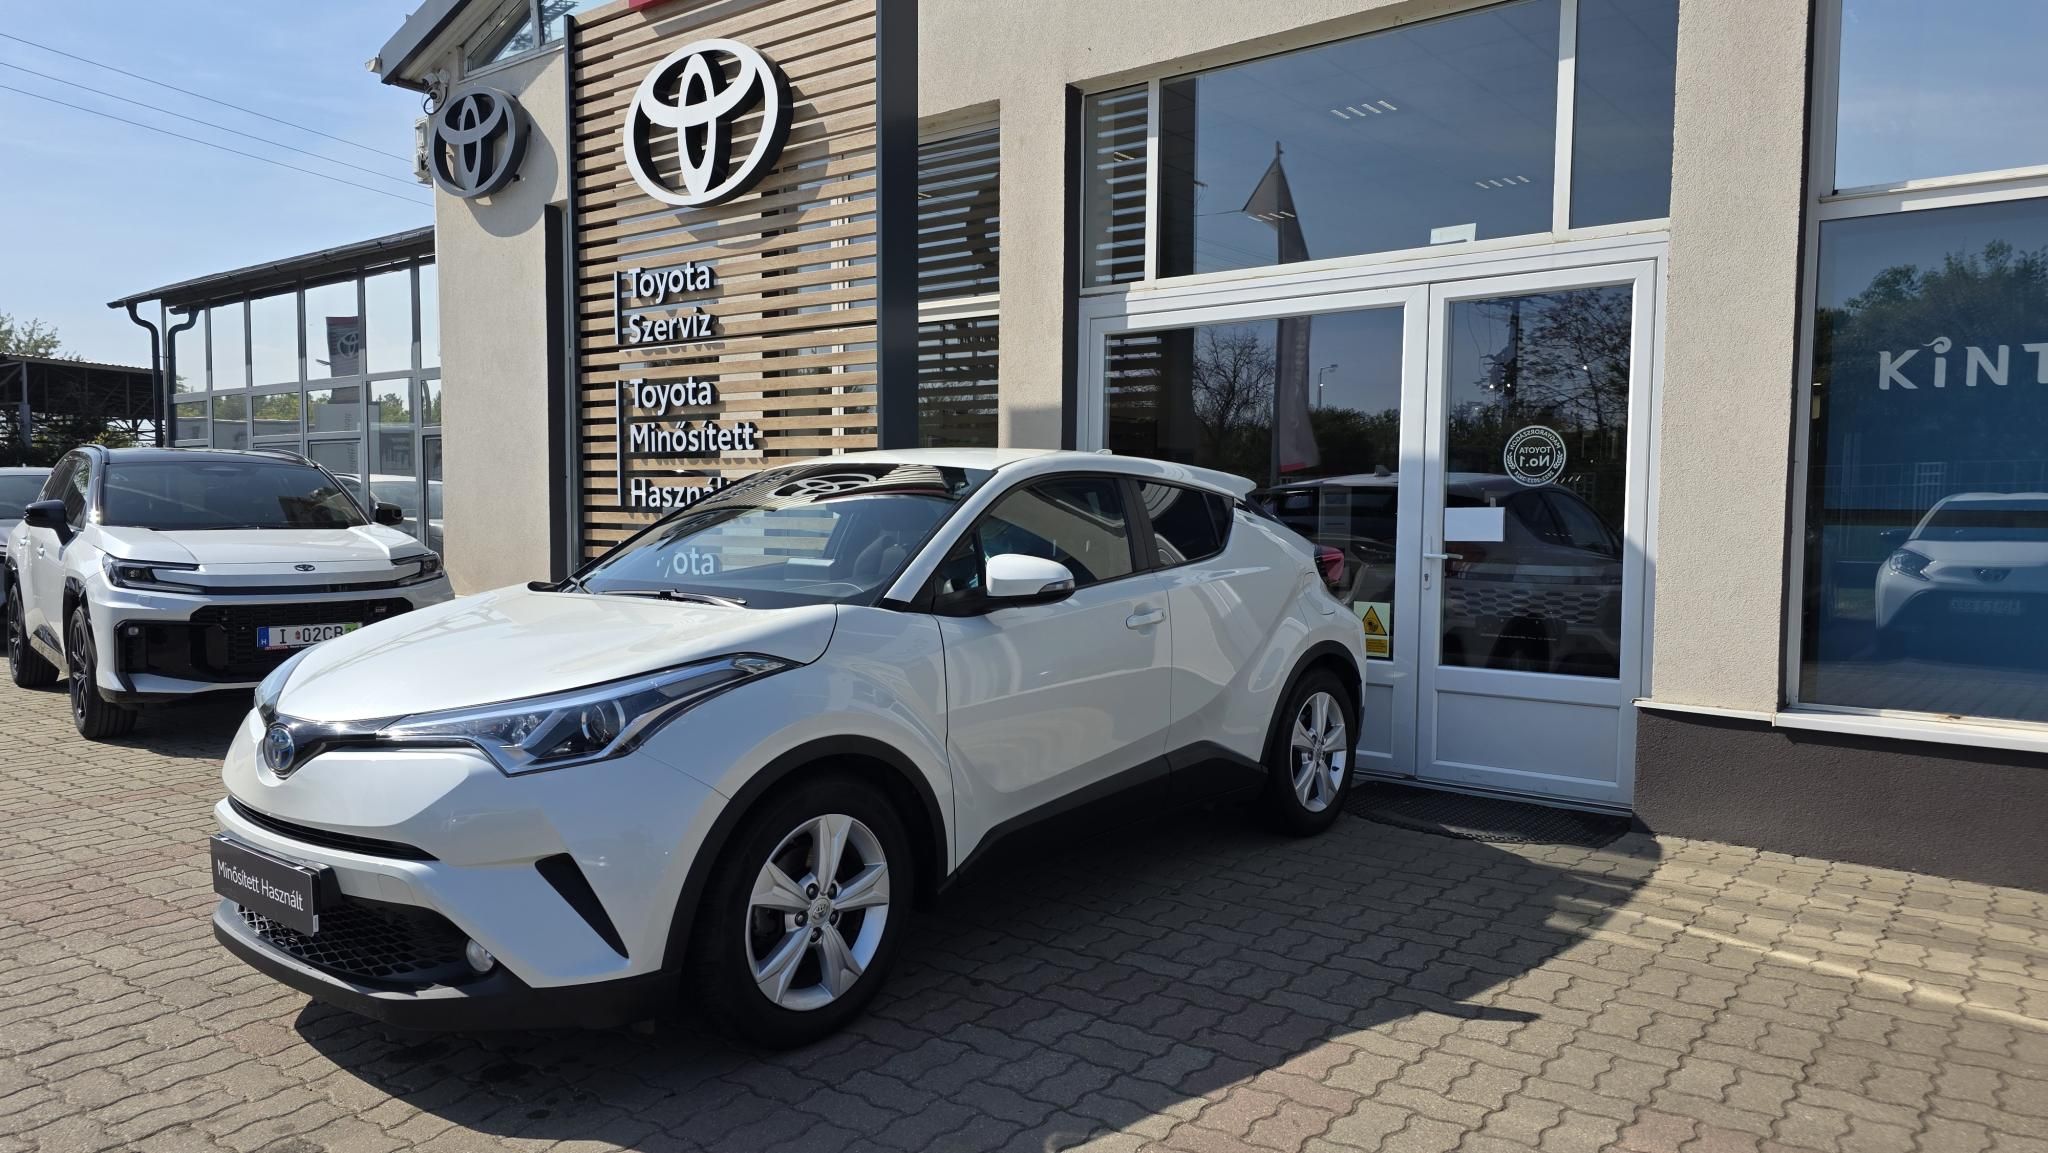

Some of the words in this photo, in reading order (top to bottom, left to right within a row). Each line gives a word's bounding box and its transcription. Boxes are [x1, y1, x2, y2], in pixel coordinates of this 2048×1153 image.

[628, 261, 710, 304] Toyota
[629, 307, 712, 344] Szerviz
[630, 376, 712, 416] Toyota
[630, 420, 755, 453] Minősített
[261, 878, 304, 912] Használt
